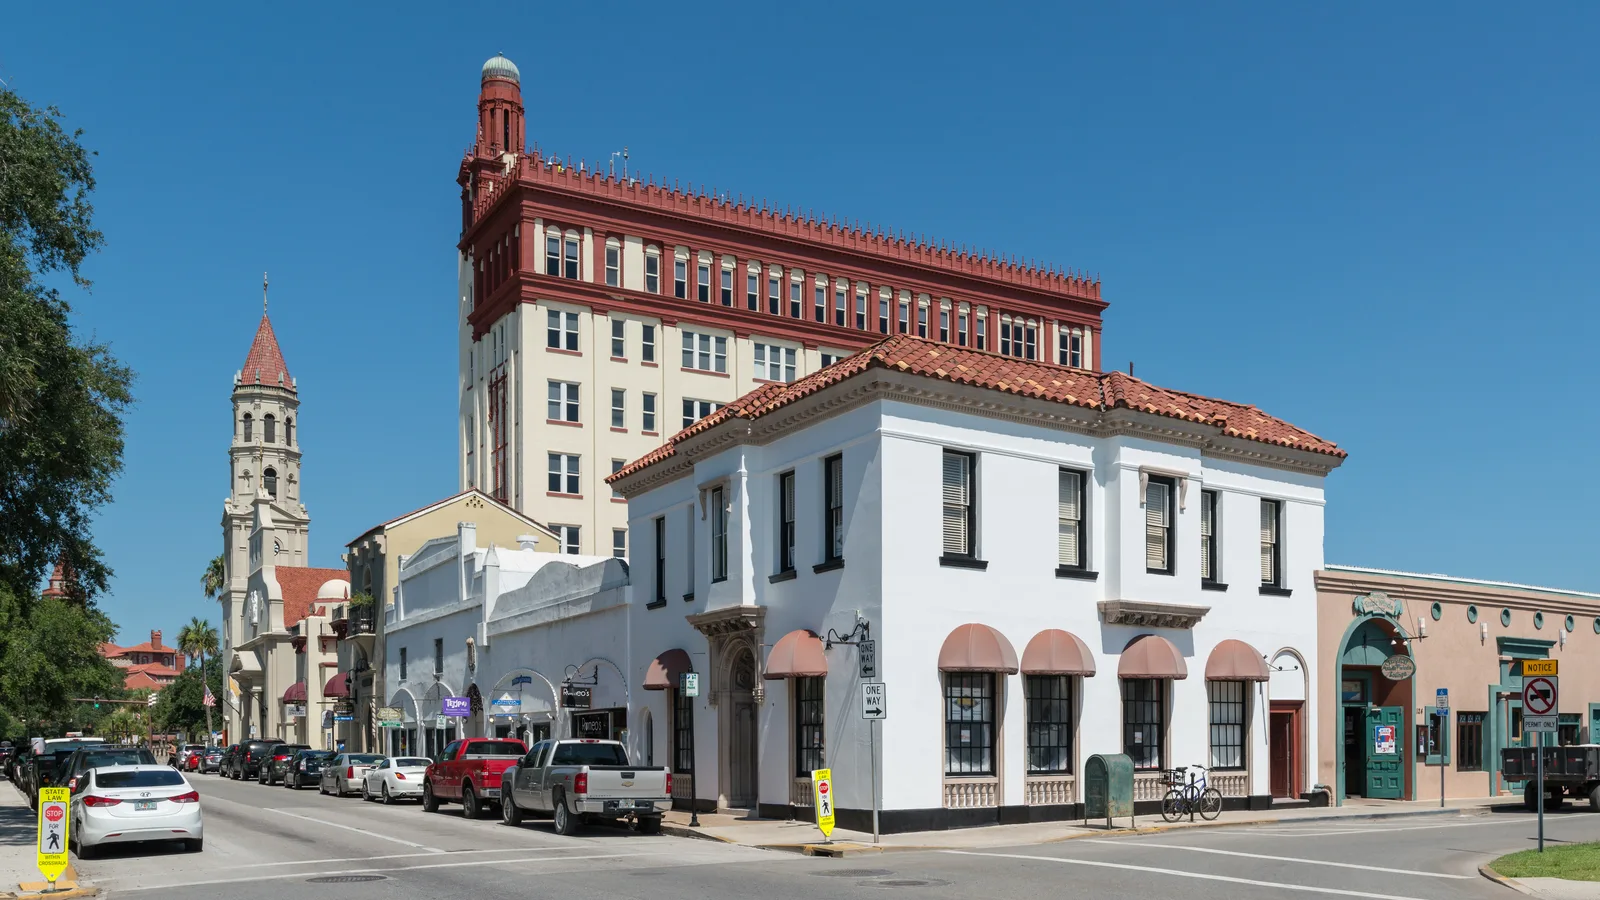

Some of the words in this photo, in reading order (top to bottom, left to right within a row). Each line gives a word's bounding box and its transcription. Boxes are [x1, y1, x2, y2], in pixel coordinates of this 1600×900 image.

[860, 643, 873, 653] ONE
[861, 654, 874, 663] WAY
[1527, 663, 1552, 672] NOTICE
[865, 685, 881, 695] ONE
[866, 696, 881, 706] WAY
